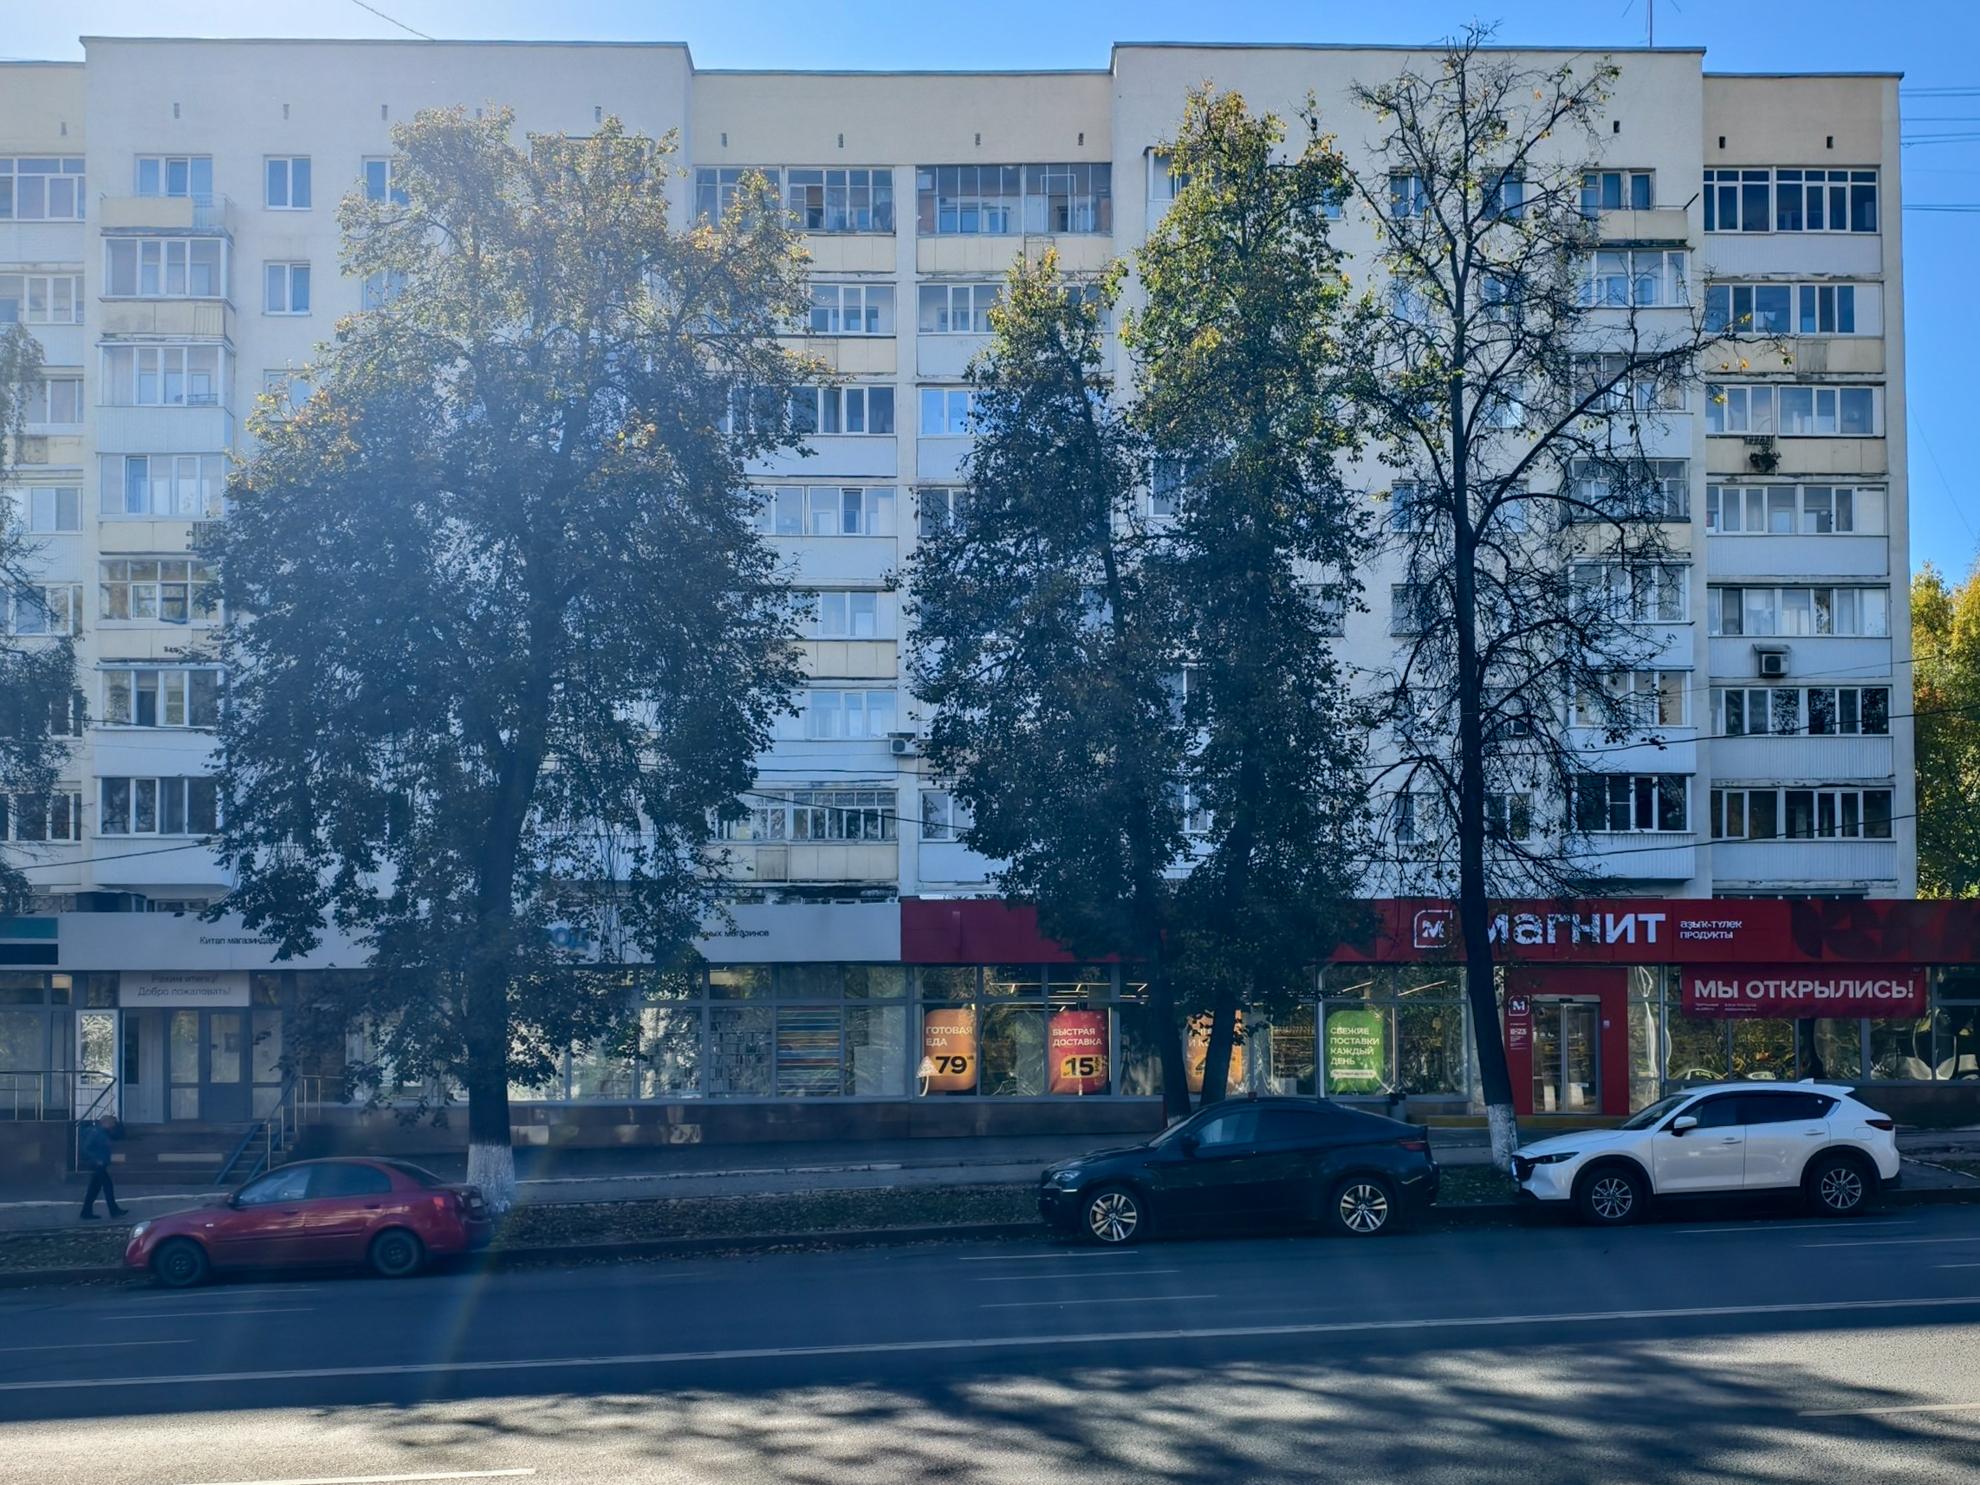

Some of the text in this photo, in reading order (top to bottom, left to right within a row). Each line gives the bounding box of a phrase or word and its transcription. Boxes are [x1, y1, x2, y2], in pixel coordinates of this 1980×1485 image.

[136, 985, 232, 997] Добро пожаловать!
[1694, 980, 1914, 999] МЫ ОТКРЫЛИСЬ!
[926, 1026, 973, 1035] ГОТОВАЯ
[1052, 1027, 1096, 1037] БЫСТРАЯ
[1330, 1027, 1370, 1035] СВЕЖИЕ
[926, 1038, 948, 1047] ЕДА
[1052, 1038, 1103, 1048] ДОСТАВКА
[1330, 1037, 1380, 1046] ПОСТАВКИ
[1330, 1046, 1375, 1056] КАЖДЫЙ
[935, 1055, 968, 1075] 79
[1065, 1057, 1094, 1076] 15
[1330, 1057, 1356, 1066] ДЕНЬ
